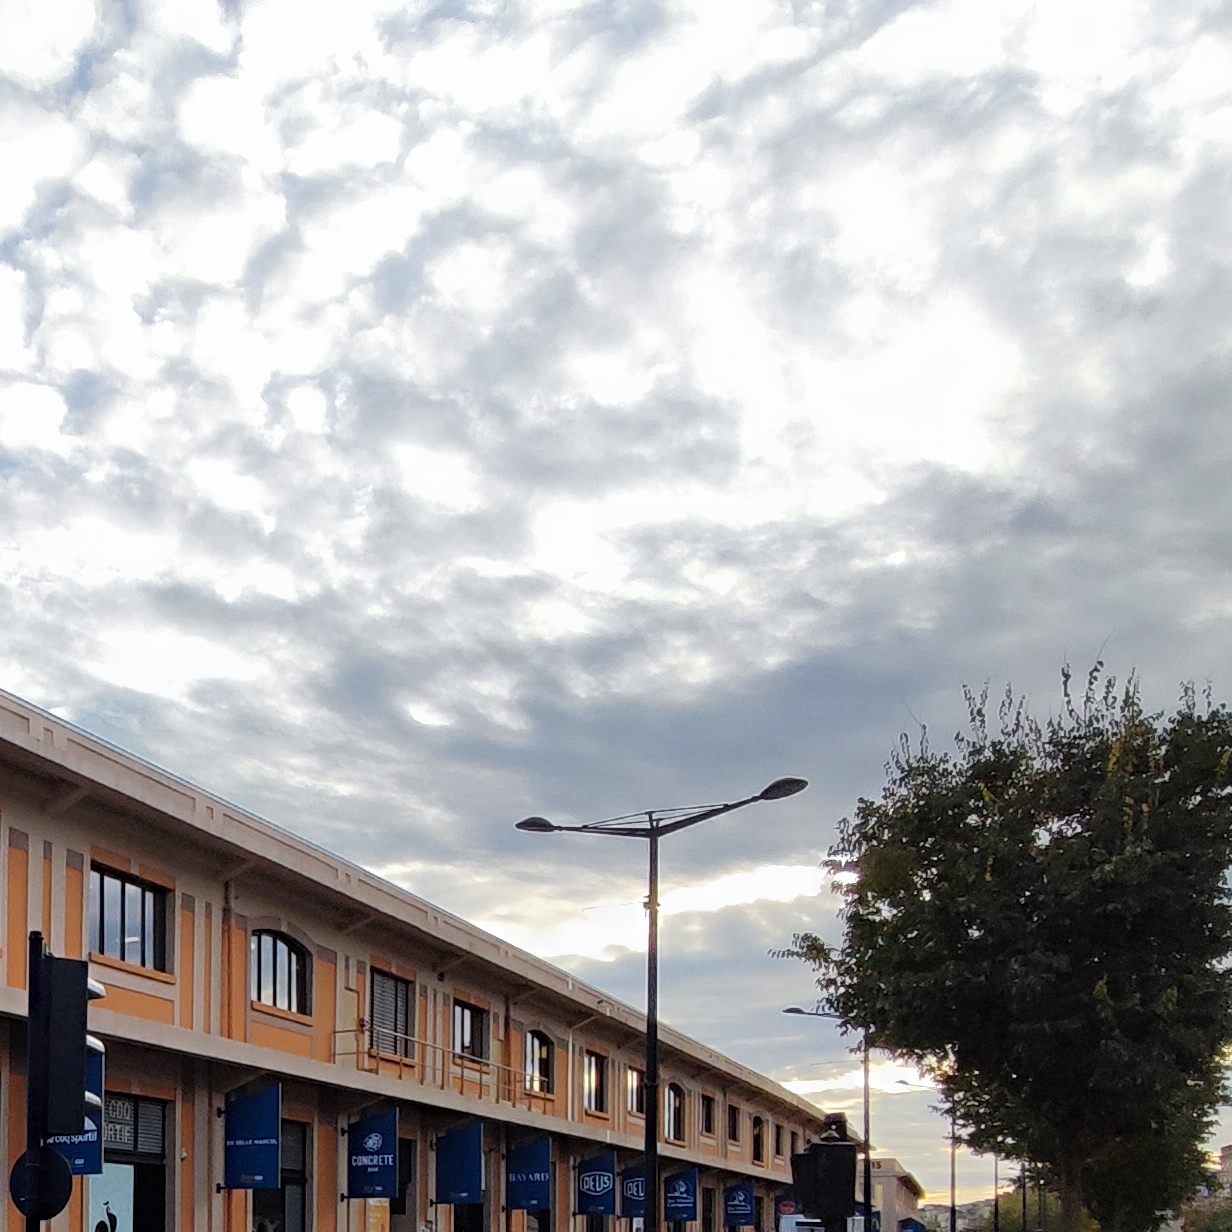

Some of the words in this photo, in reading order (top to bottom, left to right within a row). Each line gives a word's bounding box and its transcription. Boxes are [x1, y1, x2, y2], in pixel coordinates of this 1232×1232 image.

[109, 1100, 131, 1120] COQ
[351, 1154, 394, 1167] CONCRETE
[509, 1172, 550, 1182] BAYARD
[583, 1174, 610, 1191] DEUS
